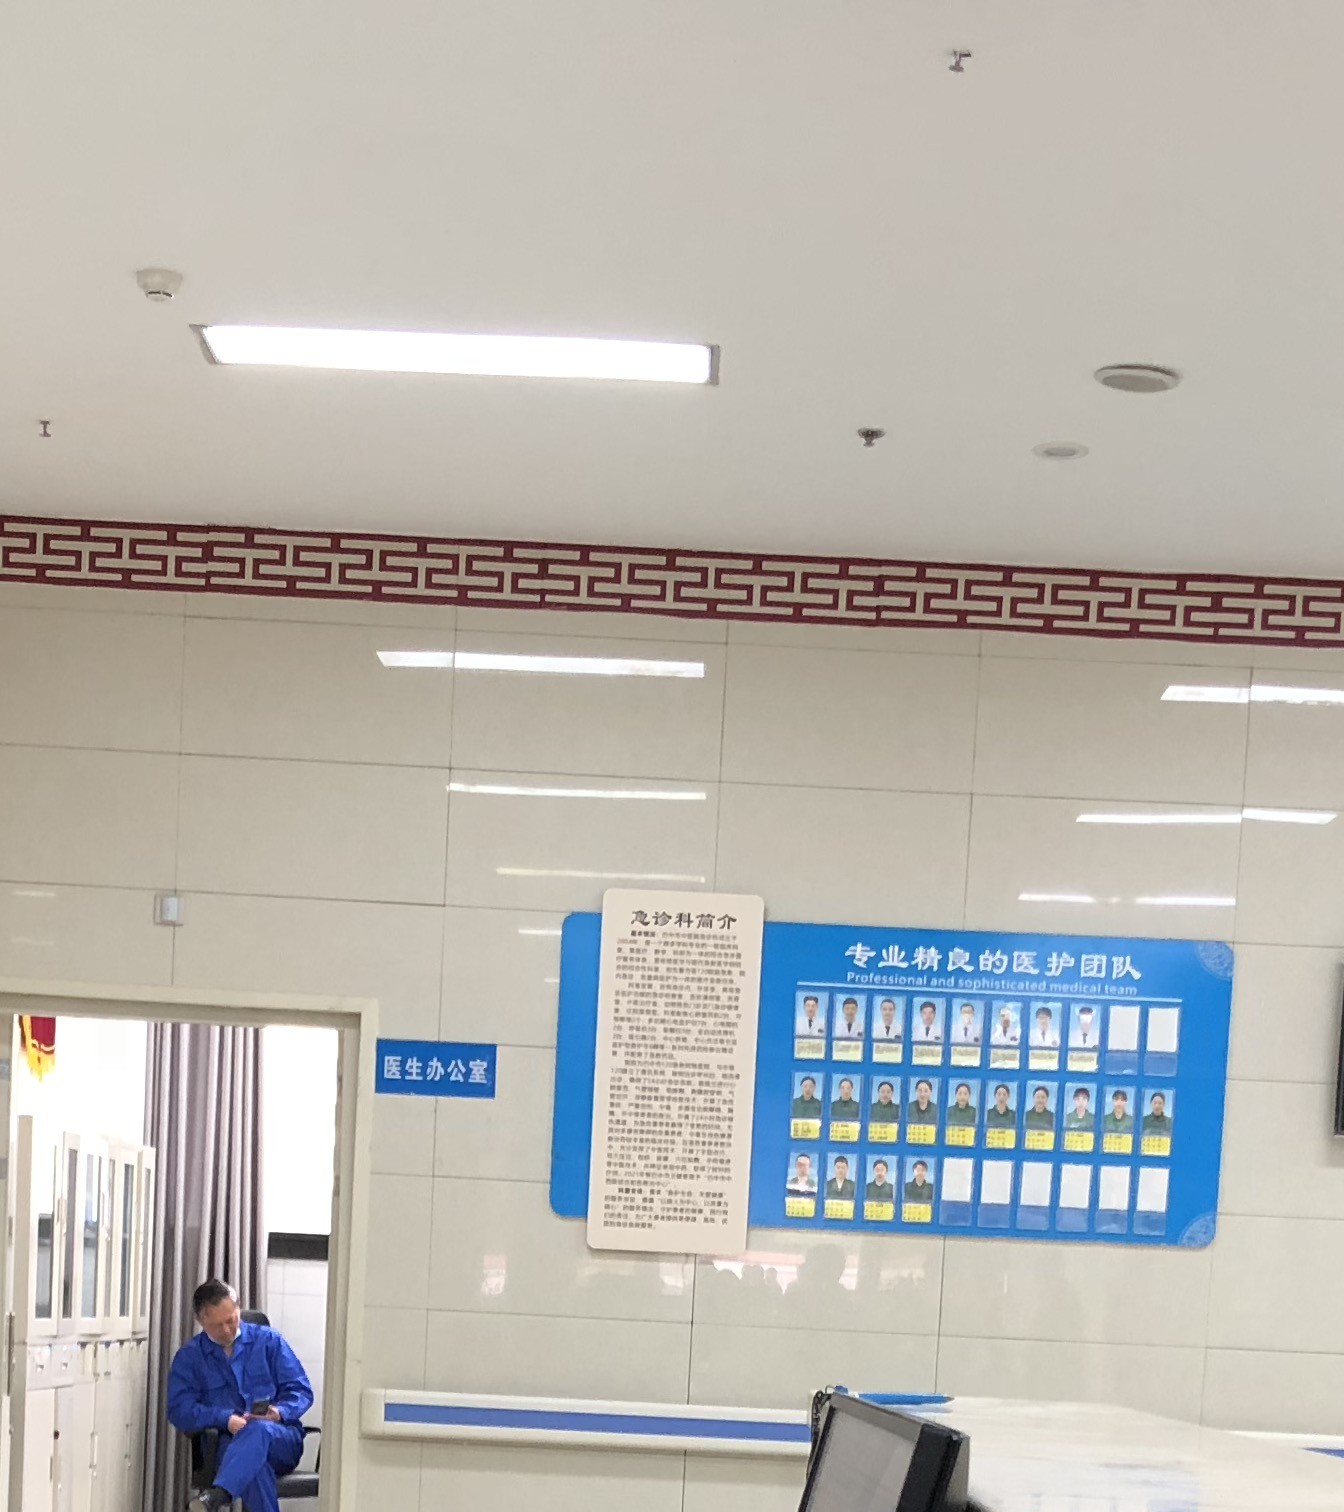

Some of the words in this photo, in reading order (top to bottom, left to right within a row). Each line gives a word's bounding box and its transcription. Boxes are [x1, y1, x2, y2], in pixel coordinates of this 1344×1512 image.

[630, 909, 737, 930] 急诊科简介
[844, 941, 1142, 980] 专业精良的医护团队
[846, 972, 927, 986] Professional
[930, 975, 954, 987] and
[958, 976, 1047, 992] sophisticated
[1050, 982, 1101, 994] medical
[1105, 984, 1138, 996] team
[383, 1055, 488, 1083] 医生办公室
